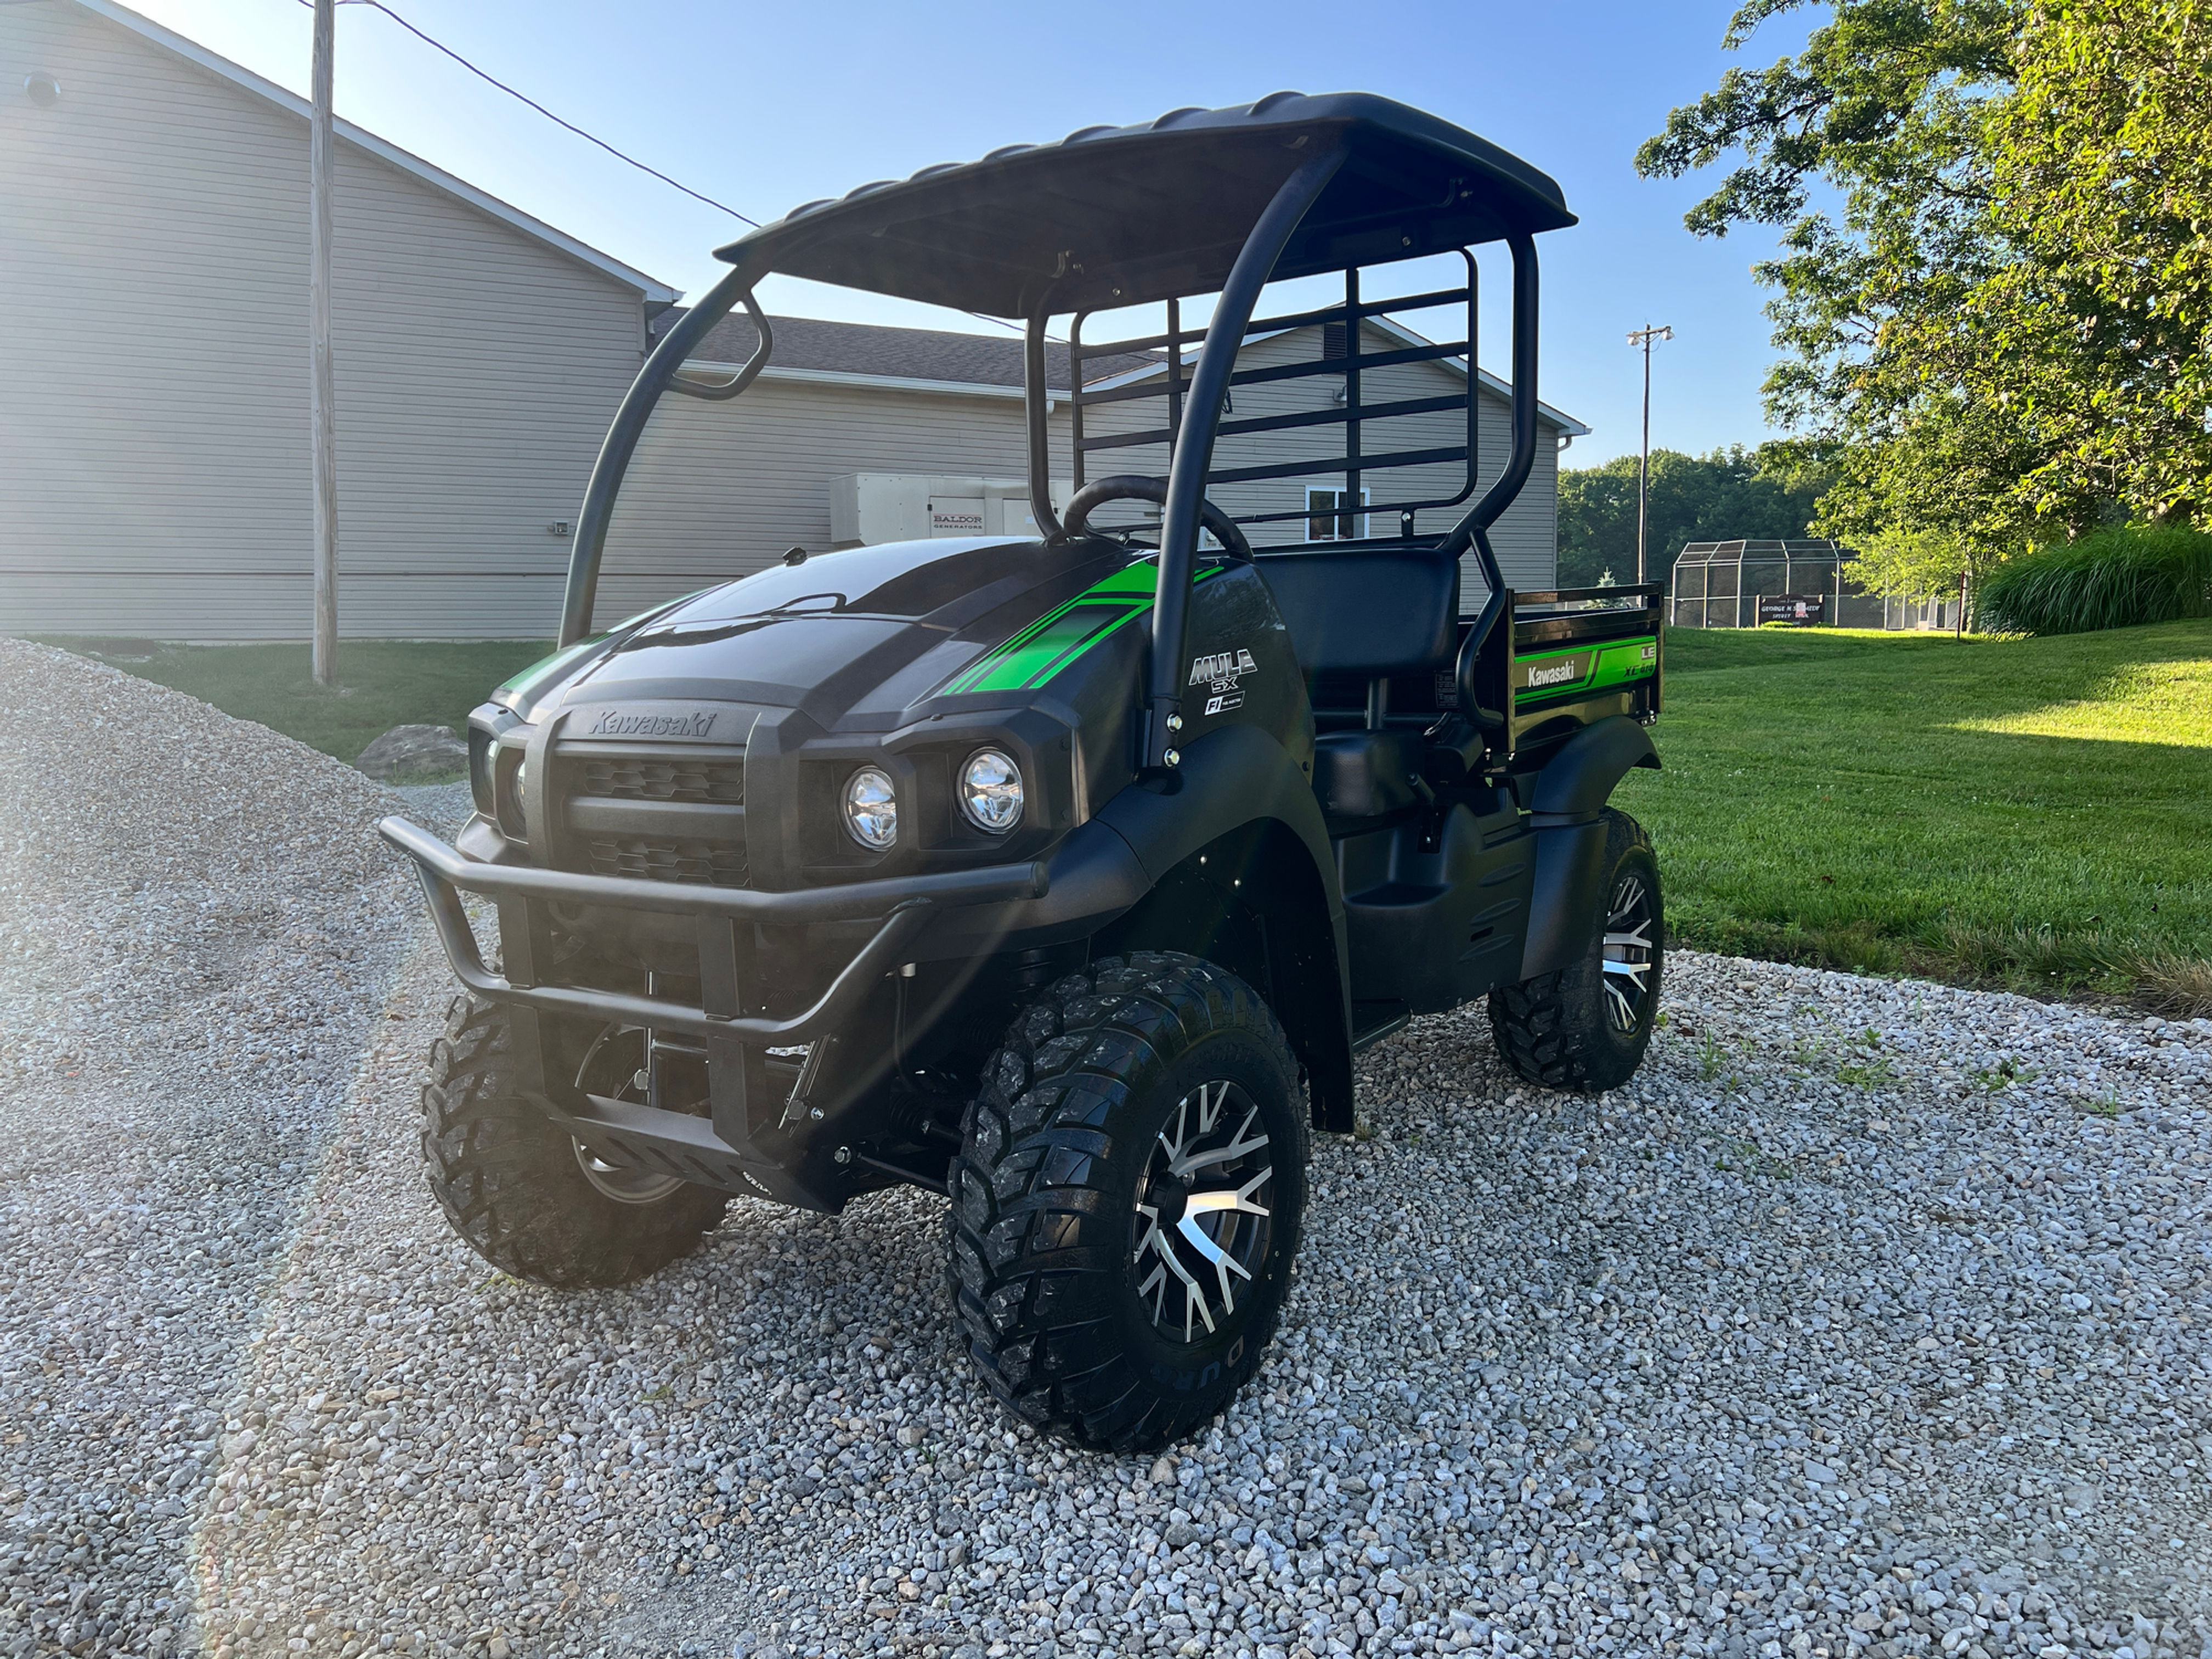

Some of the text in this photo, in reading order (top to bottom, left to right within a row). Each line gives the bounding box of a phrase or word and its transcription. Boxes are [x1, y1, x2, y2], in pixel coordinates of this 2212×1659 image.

[1641, 646, 1655, 659] LE
[1188, 648, 1258, 686] MULE
[1528, 660, 1574, 687] Kawasaki
[1211, 676, 1238, 693] SX
[1207, 699, 1220, 712] FI
[589, 711, 718, 737] Kawasaki
